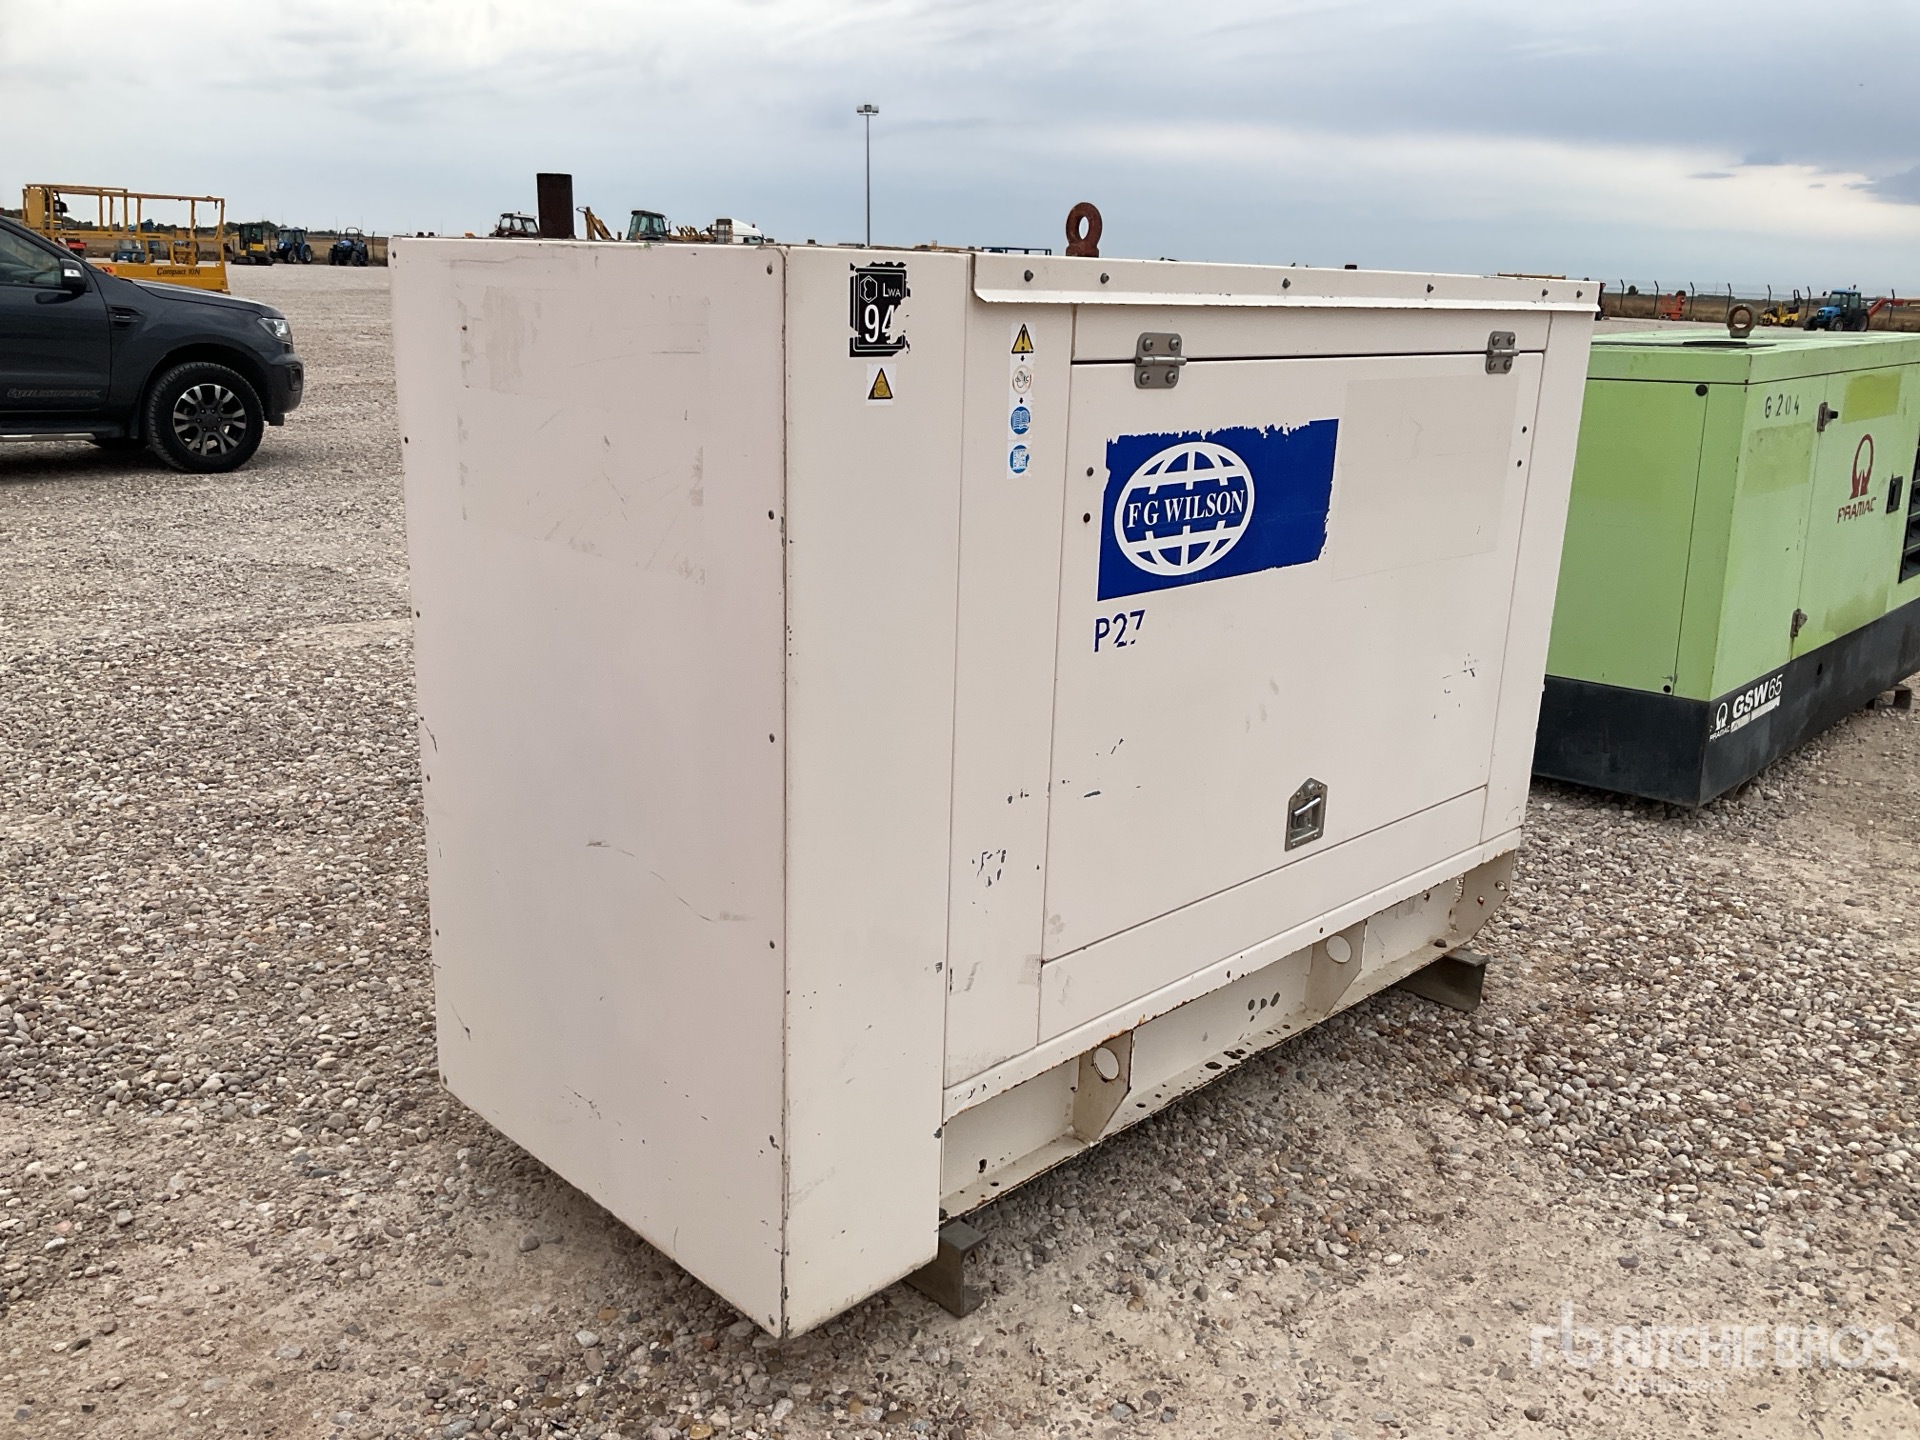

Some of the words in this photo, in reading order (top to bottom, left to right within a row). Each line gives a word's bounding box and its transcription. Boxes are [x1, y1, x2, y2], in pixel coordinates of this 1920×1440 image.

[156, 266, 187, 277] Compact
[1163, 489, 1246, 523] WILSON
[1836, 497, 1877, 523] PRAMAC
[1094, 609, 1146, 653] P27
